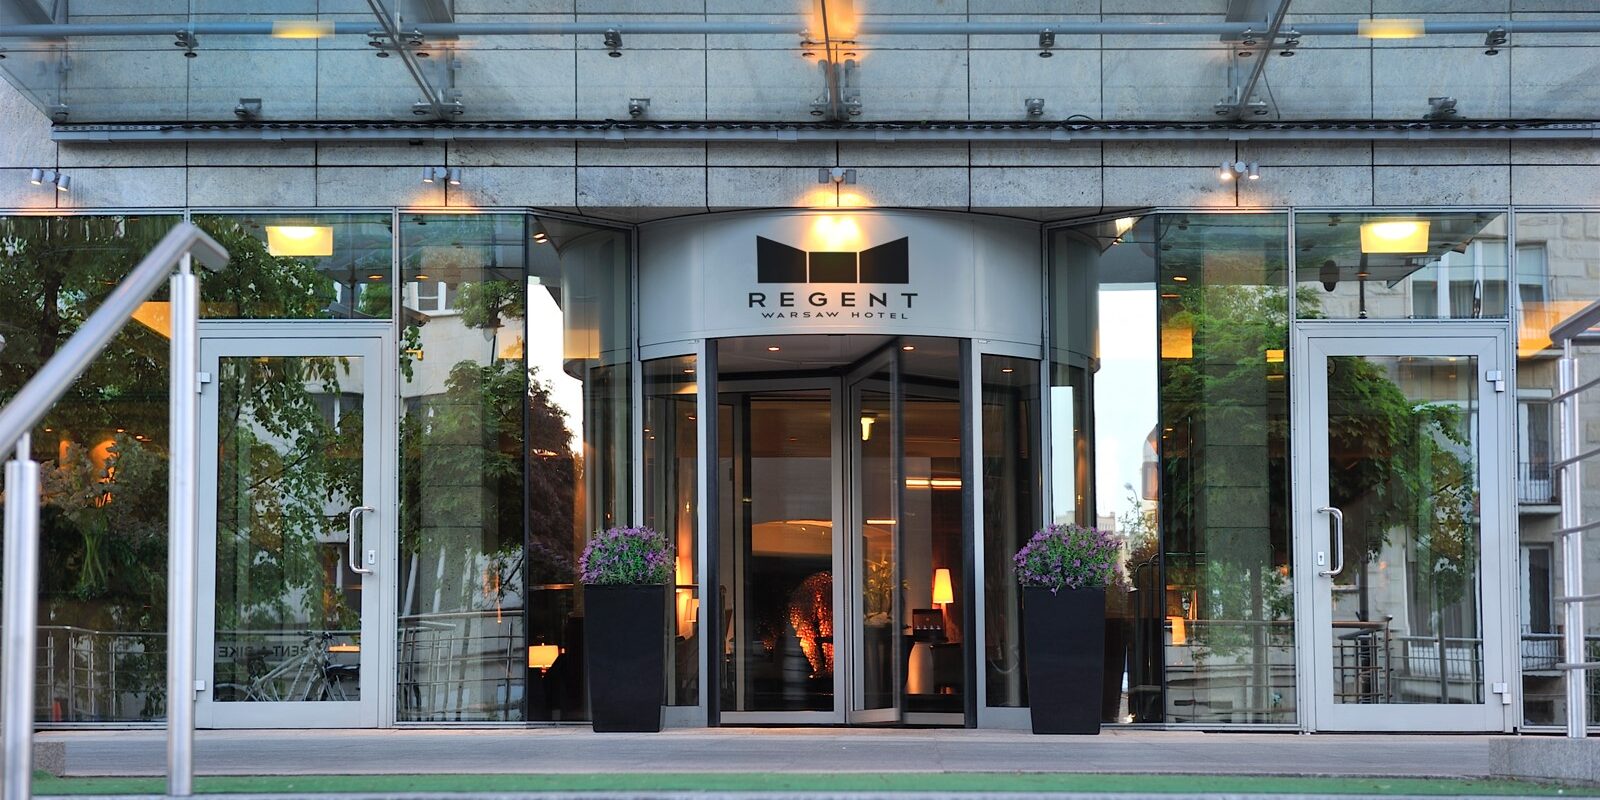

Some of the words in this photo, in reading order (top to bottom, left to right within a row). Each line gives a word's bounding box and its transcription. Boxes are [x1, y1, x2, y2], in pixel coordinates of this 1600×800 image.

[748, 292, 918, 308] REGENT
[761, 311, 839, 319] WARSAW
[851, 311, 908, 320] HOTEL
